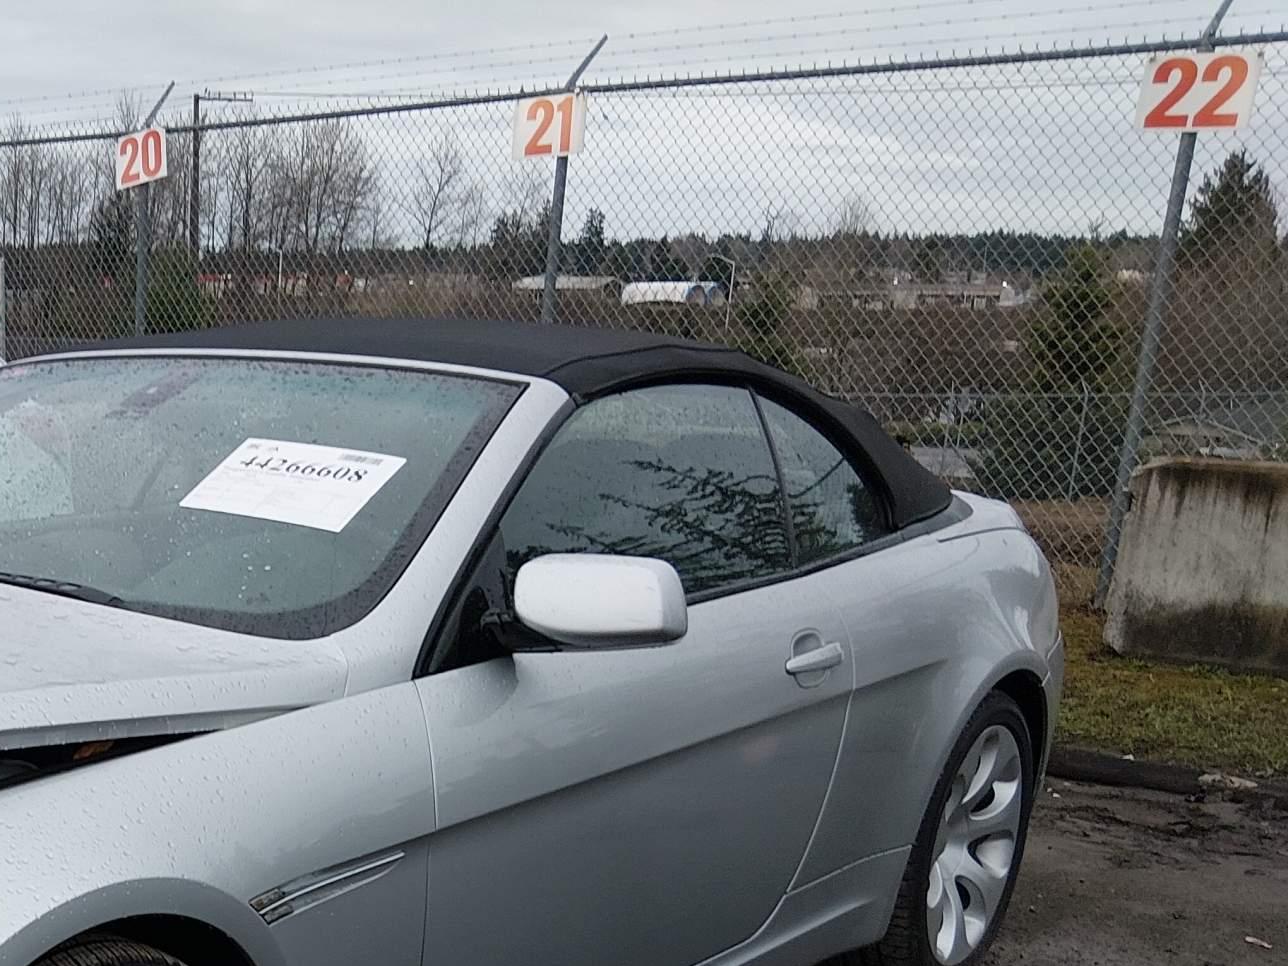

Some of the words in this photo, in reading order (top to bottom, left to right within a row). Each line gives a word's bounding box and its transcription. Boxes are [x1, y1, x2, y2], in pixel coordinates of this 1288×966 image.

[1143, 55, 1249, 128] 22
[524, 96, 574, 156] 21
[119, 130, 162, 185] 20
[240, 455, 368, 482] 44266608
